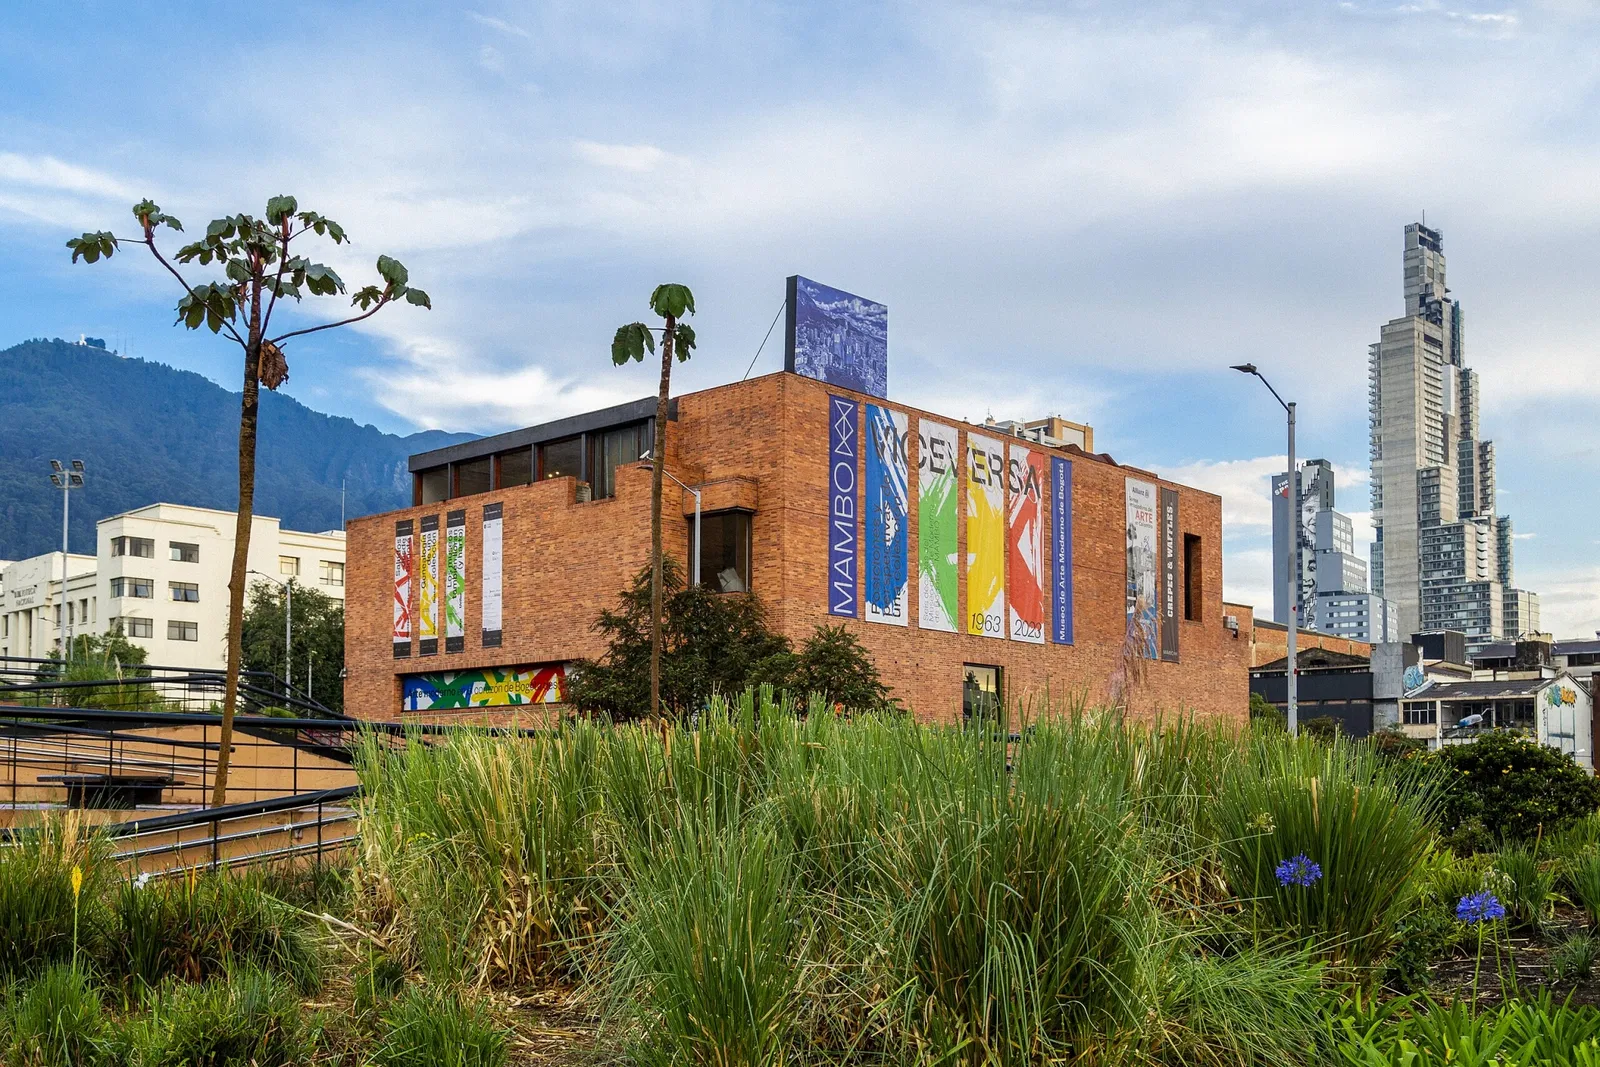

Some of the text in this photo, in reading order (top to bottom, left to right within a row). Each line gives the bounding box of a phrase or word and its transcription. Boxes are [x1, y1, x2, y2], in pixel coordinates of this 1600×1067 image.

[871, 420, 1041, 499] VICEVERSA
[1058, 502, 1064, 515] de
[1135, 509, 1153, 524] ARTE
[834, 462, 854, 614] MAMBO
[880, 475, 893, 617] perspectivas de
[871, 503, 883, 614] Posiciones y
[892, 495, 902, 617] una colección
[1059, 590, 1065, 604] de
[971, 612, 1002, 633] 1963
[1014, 618, 1042, 639] 2023
[503, 681, 514, 692] de
